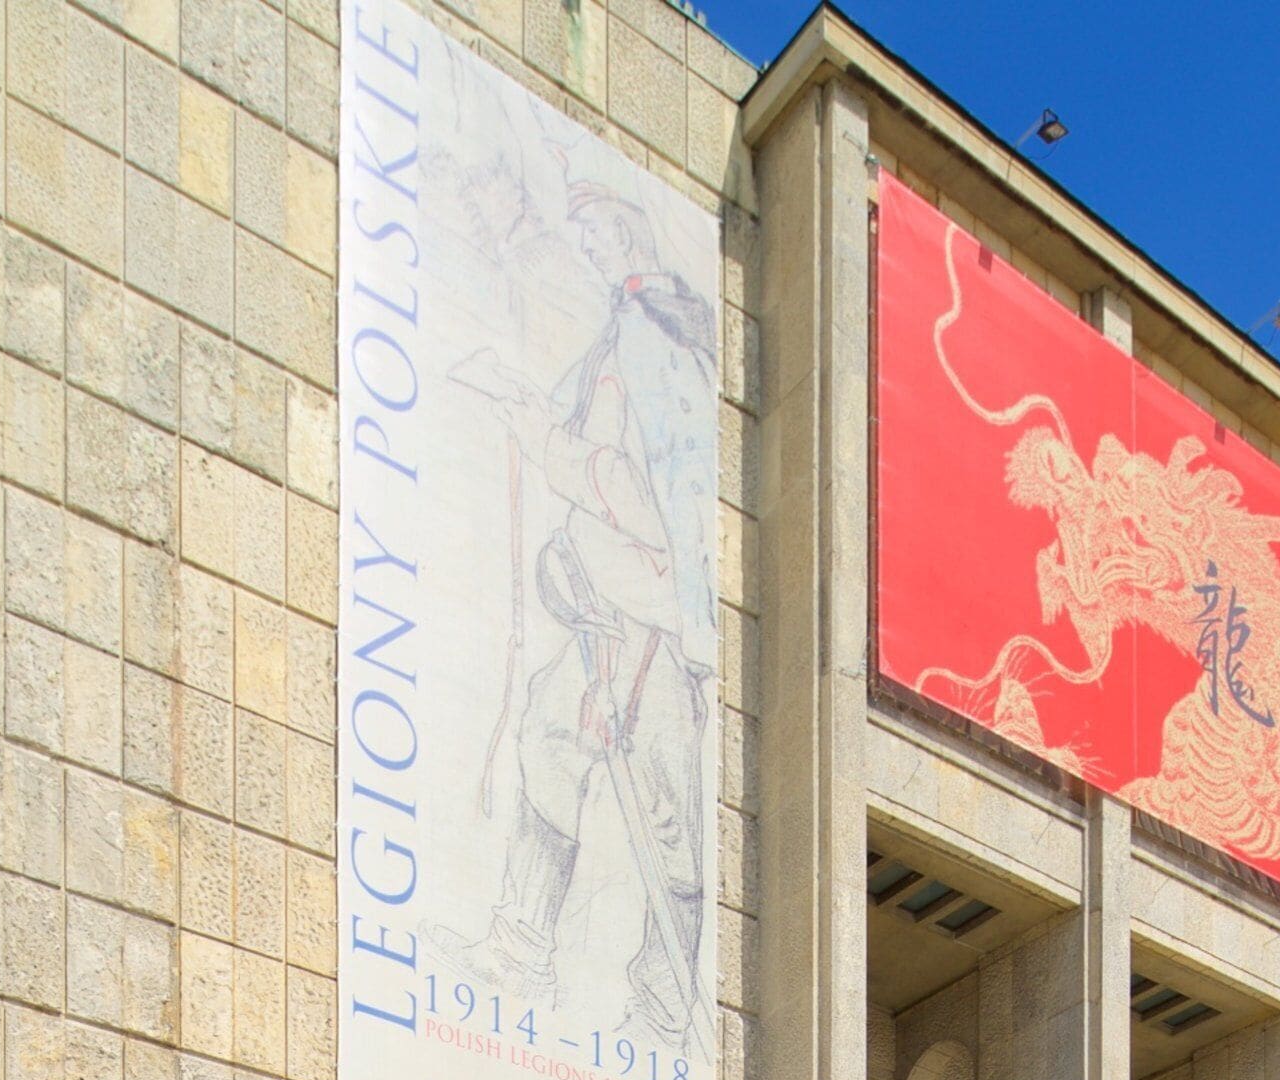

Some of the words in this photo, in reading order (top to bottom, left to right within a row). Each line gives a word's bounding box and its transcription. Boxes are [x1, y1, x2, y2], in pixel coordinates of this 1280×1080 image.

[351, 4, 419, 485] POLSKIE
[350, 515, 418, 1034] LEGIONY
[425, 1018, 501, 1060] POLISH
